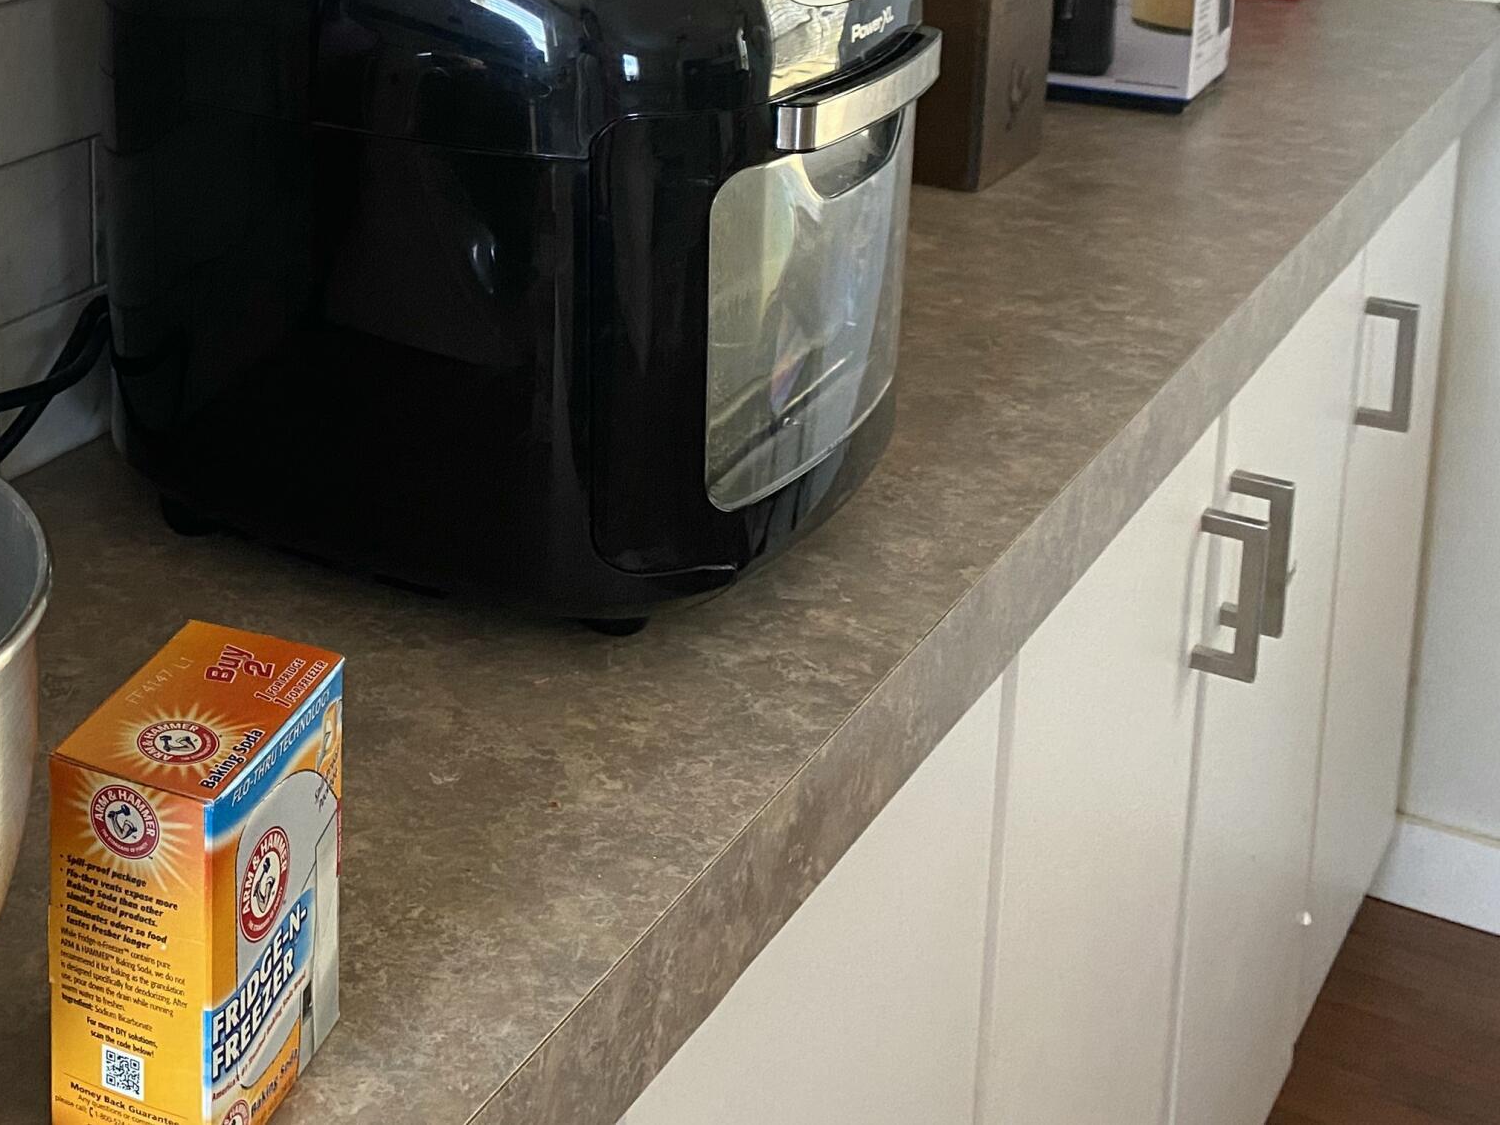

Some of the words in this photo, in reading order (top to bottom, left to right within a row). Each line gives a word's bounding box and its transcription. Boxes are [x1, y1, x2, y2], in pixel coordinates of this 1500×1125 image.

[206, 645, 253, 683] Buy
[244, 660, 275, 679] 2
[255, 692, 272, 701] 1
[266, 680, 284, 696] FOR
[279, 659, 305, 683] FRIDGE
[274, 698, 291, 707] 1
[286, 686, 302, 702] FOR
[298, 661, 327, 689] FREEZER
[144, 723, 200, 740] HAMMER
[231, 750, 278, 807] FLO-THRU
[278, 690, 331, 756] TECHNOLOGY
[201, 754, 246, 790] Baking
[233, 729, 265, 755] Soda
[95, 794, 110, 822] ARM
[107, 790, 117, 801] &
[118, 789, 156, 837] HAMMER
[66, 854, 111, 876] Spill-proof
[112, 871, 147, 887] package
[66, 868, 98, 885] Flo-thru
[100, 880, 122, 893] vents
[124, 887, 153, 902] expose
[156, 898, 178, 910] more
[243, 871, 254, 914] ARM
[252, 855, 260, 870] &
[260, 833, 287, 874] HAMMER
[66, 879, 94, 897] Baking
[97, 890, 117, 903] Soda
[119, 896, 138, 909] than
[140, 903, 164, 917] other
[66, 891, 94, 907] similar
[97, 900, 118, 914] sized
[118, 908, 158, 928] products.
[66, 904, 108, 925] Eliminates
[110, 917, 133, 933] odors
[136, 928, 146, 937] so
[147, 931, 168, 944] food
[66, 916, 90, 931] tastes
[91, 924, 121, 940] fresher
[122, 934, 151, 950] longer
[130, 950, 156, 965] contains
[212, 904, 308, 1045] FRIDGE-N-
[125, 982, 133, 992] for
[172, 998, 188, 1009] After
[139, 975, 149, 985] the
[164, 973, 174, 982] do
[175, 977, 185, 986] not
[86, 1015, 97, 1026] For
[98, 1020, 114, 1033] more
[115, 1024, 127, 1037] DIY
[212, 948, 295, 1079] FREEZER
[90, 1029, 104, 1041] scan
[105, 1034, 115, 1044] the
[116, 1038, 132, 1050] code
[132, 1043, 155, 1059] below!
[70, 1081, 102, 1102] Money
[104, 1094, 126, 1110] Back
